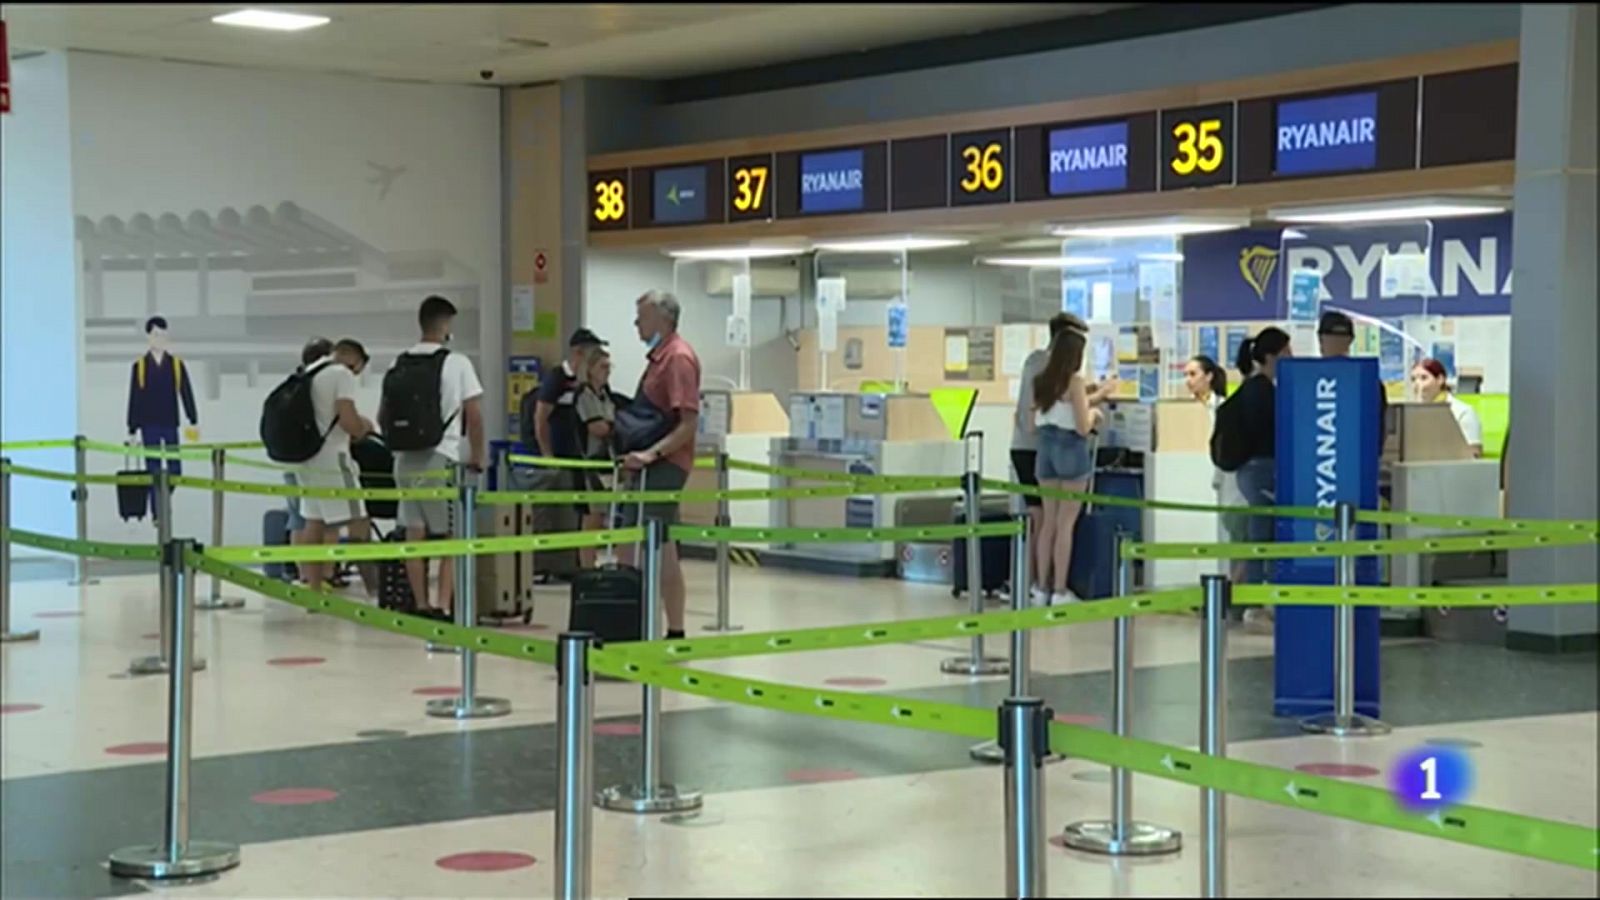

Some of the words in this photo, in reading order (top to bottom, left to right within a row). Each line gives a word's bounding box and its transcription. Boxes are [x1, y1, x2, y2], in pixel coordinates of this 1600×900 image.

[1171, 119, 1224, 176] 35
[1278, 116, 1376, 151] RYANAIR
[960, 144, 1003, 192] 36
[1050, 143, 1128, 173] RYANAIR
[594, 180, 624, 220] 38
[734, 167, 768, 210] 37
[802, 168, 863, 193] RYANAIR
[1287, 237, 1512, 302] RYAN
